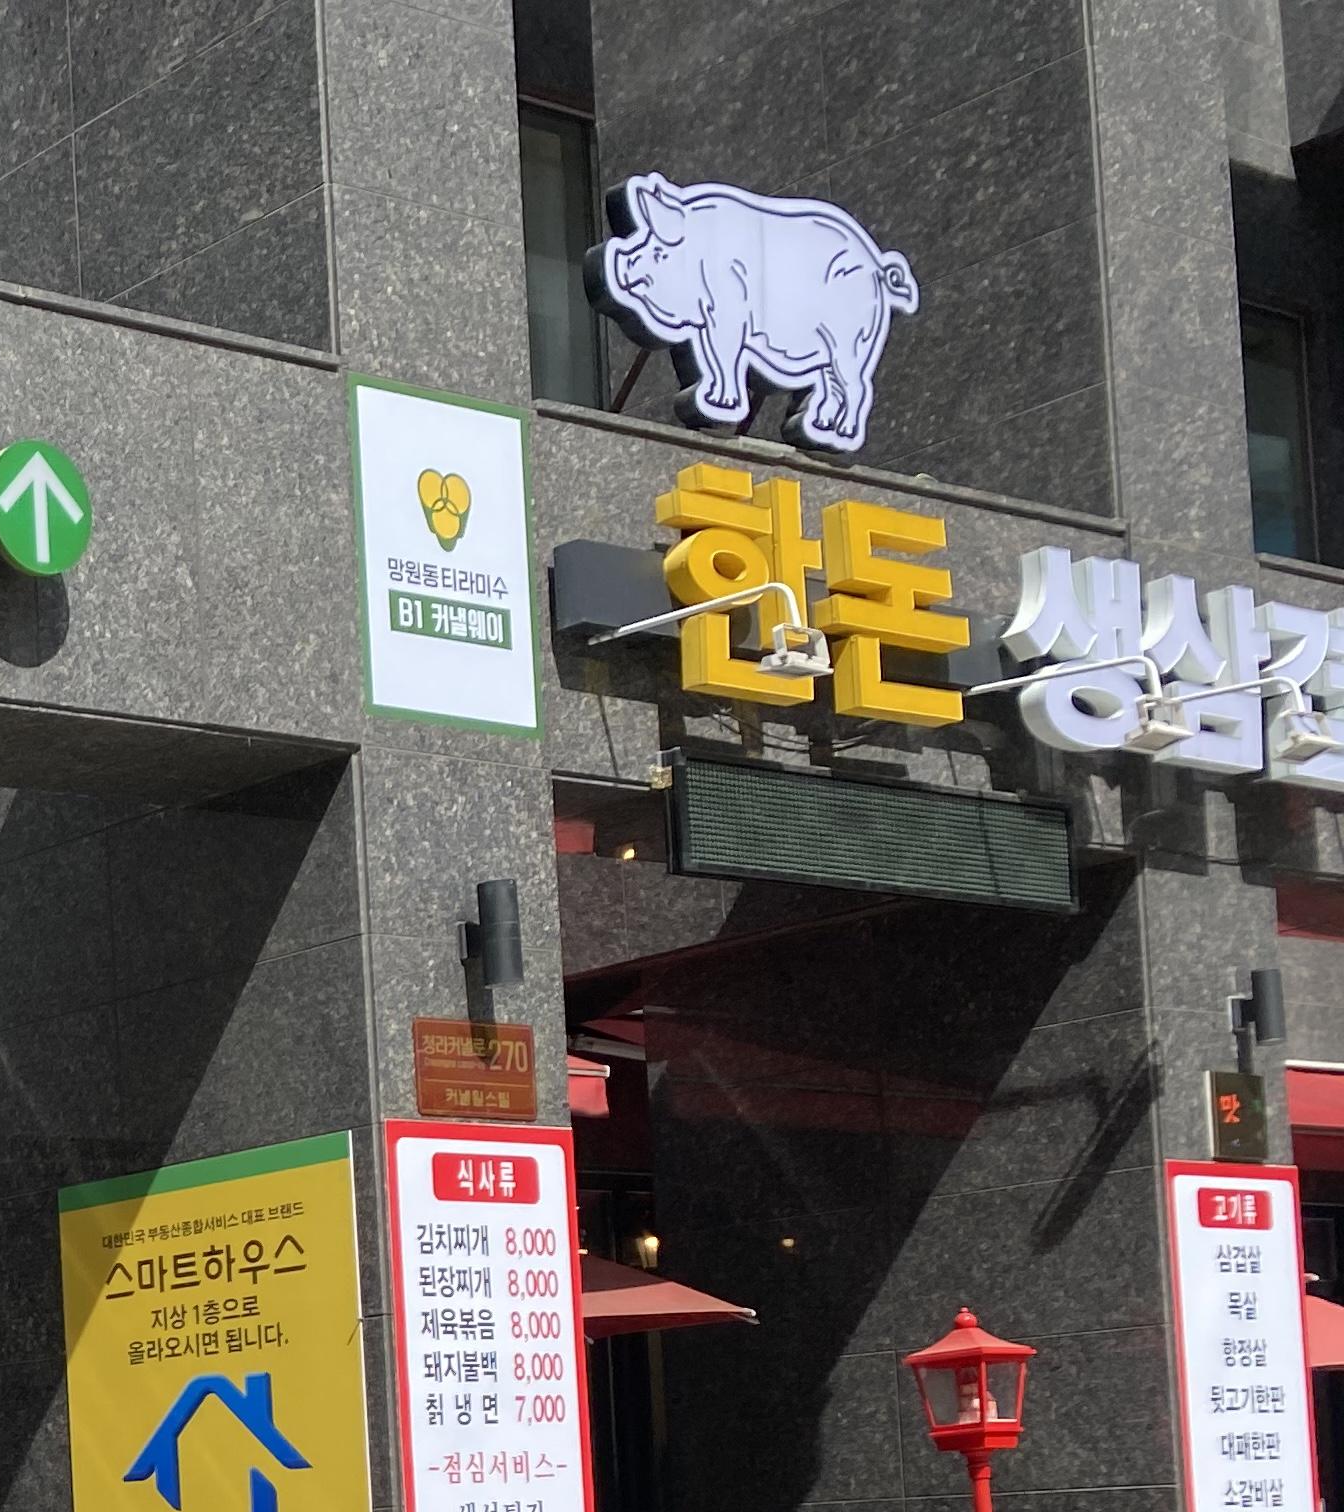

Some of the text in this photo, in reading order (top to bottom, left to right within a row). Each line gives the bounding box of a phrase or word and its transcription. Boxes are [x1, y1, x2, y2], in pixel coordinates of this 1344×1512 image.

[655, 461, 971, 728] 한돈
[399, 597, 504, 643] B1 커낼웨이
[489, 1039, 529, 1072] 270
[457, 1158, 517, 1198] 식사류
[102, 1201, 304, 1250] 대한민국 부동산종합서비스 대표 브랜드
[1211, 1193, 1257, 1225] 고기류
[417, 1223, 556, 1258] 김치찌개 8,000
[105, 1234, 307, 1300] 스마트하우스
[1217, 1244, 1261, 1273] 삼겹살
[419, 1266, 559, 1300] 된장찌개 8,000
[151, 1295, 261, 1330] 지상 1층으로
[1228, 1291, 1257, 1320] 목살
[421, 1308, 561, 1342] 제육볶음 8,000
[128, 1322, 289, 1366] 올라오시면 됩니다.
[1222, 1337, 1267, 1367] 항정살
[424, 1350, 563, 1384] 돼지불백 8,000
[515, 1394, 565, 1426] 7,000
[1220, 1431, 1281, 1461] 대패한판
